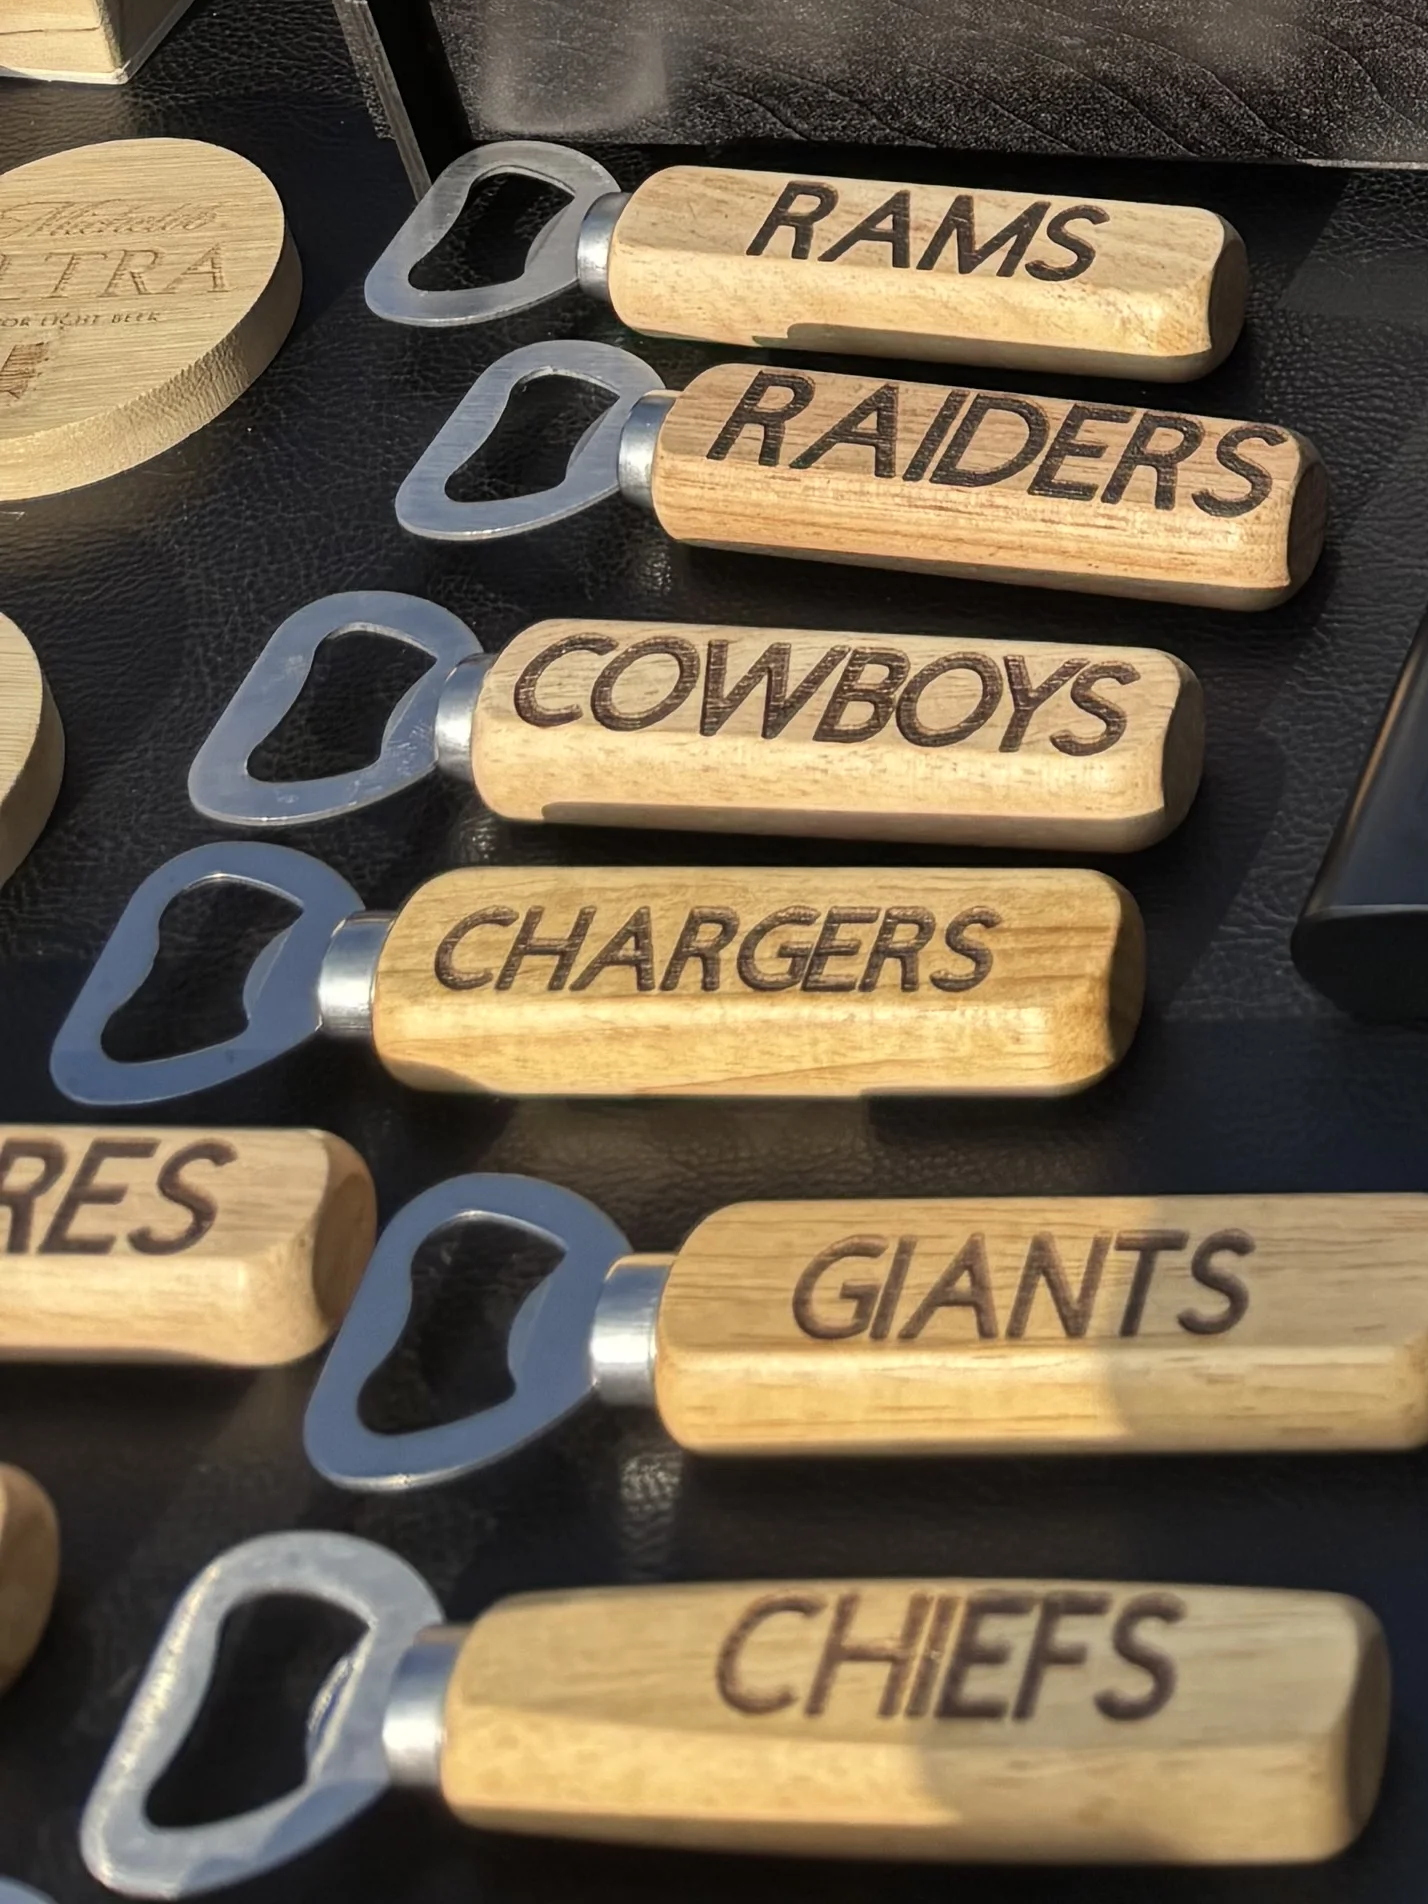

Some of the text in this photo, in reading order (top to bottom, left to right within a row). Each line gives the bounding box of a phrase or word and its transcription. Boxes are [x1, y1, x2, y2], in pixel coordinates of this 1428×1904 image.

[747, 180, 1110, 282] RAMS
[708, 370, 1290, 518] RAIDERS
[513, 633, 1140, 758] COWBOYS
[432, 905, 1005, 994] CHARGERS
[791, 1229, 1256, 1341] GIANTS
[714, 1591, 1187, 1724] CHIEFS
